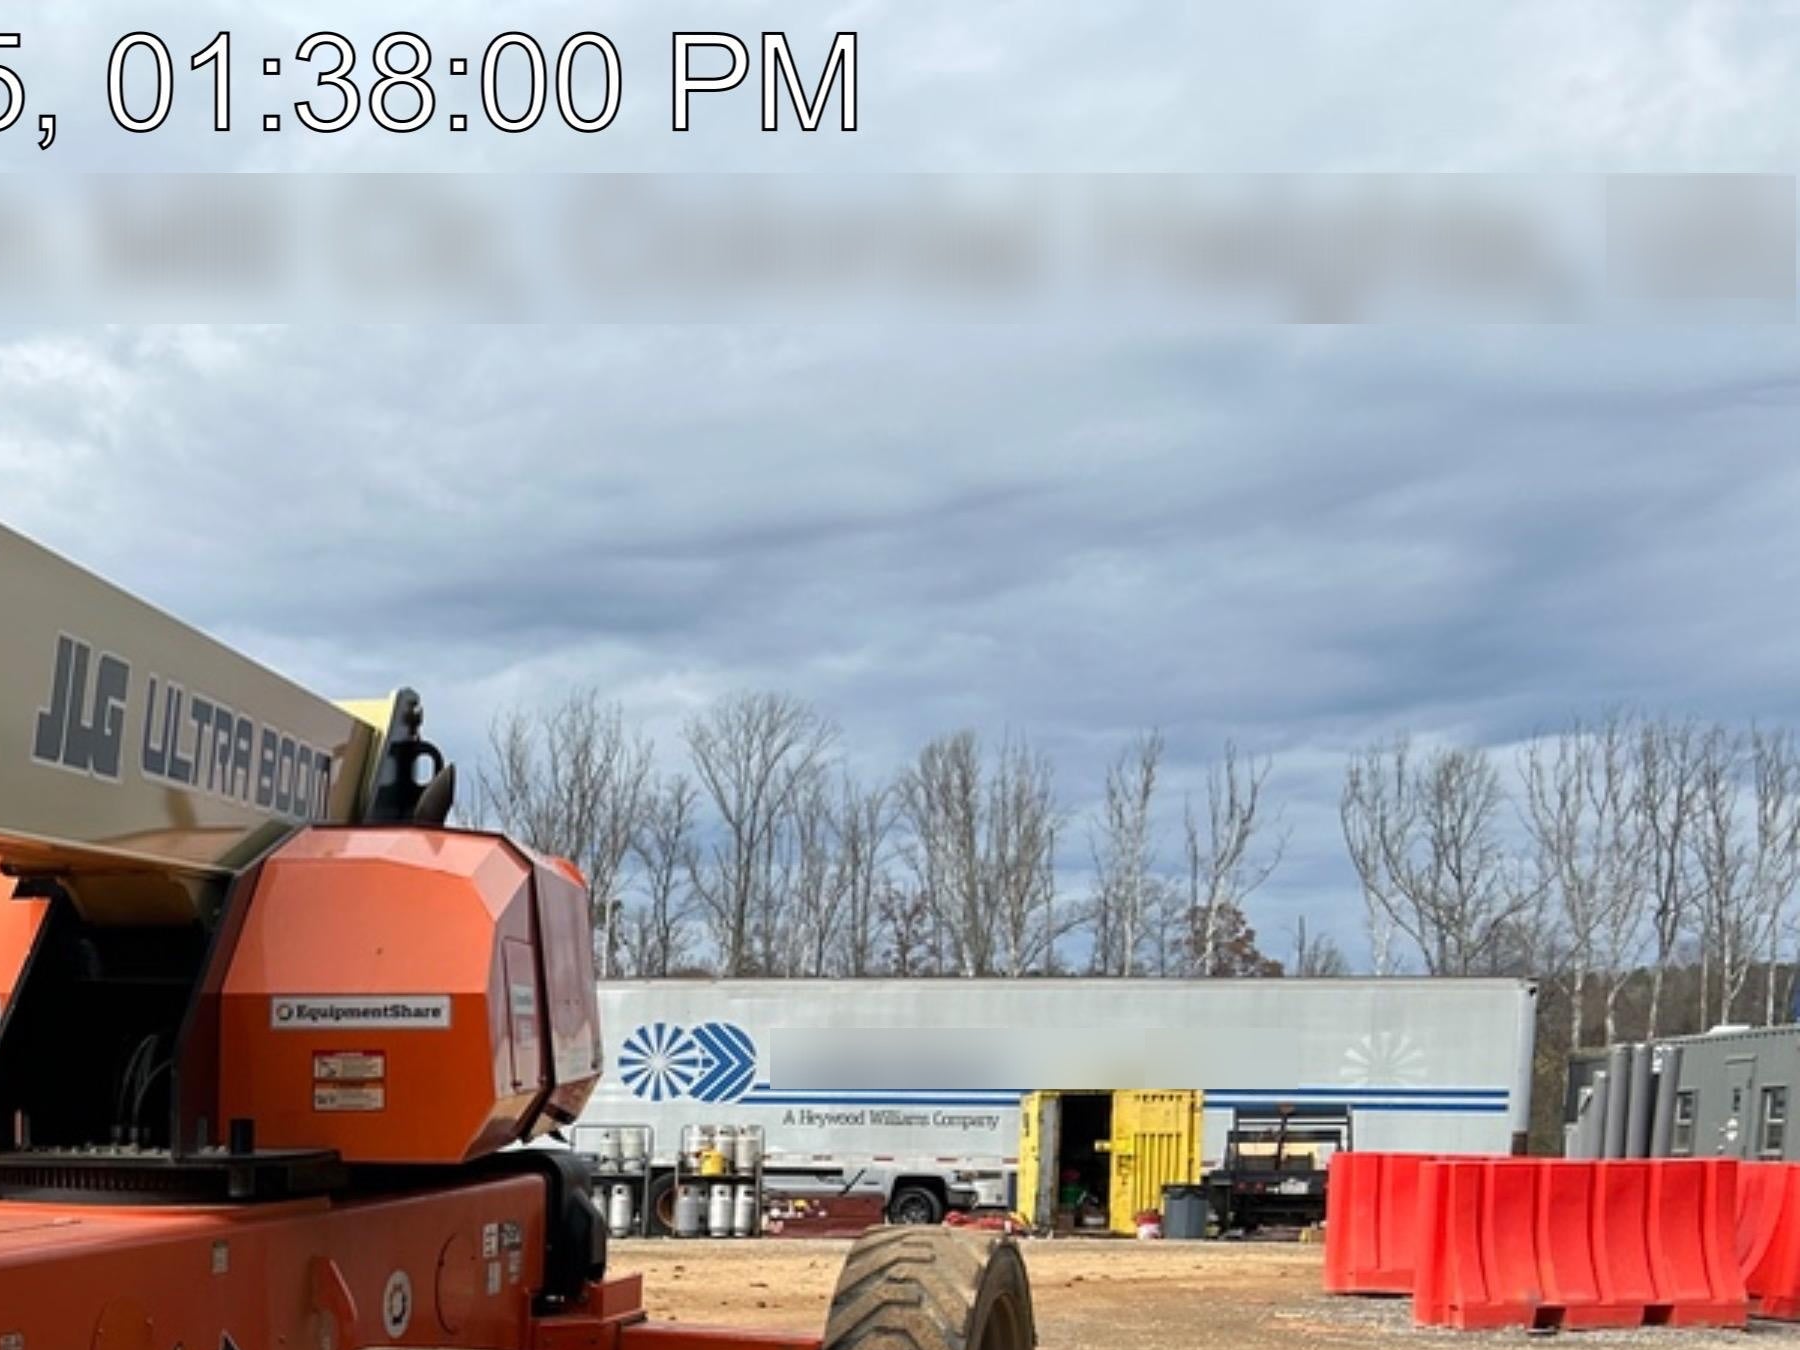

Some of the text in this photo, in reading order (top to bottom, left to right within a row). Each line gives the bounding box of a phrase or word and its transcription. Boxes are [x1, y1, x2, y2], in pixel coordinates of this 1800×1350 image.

[32, 631, 333, 820] JLG ULTRA BOOM
[295, 1003, 442, 1022] EquipmentShare
[782, 1109, 796, 1126] A
[800, 1109, 865, 1129] Heywood
[933, 1109, 1001, 1131] Company
